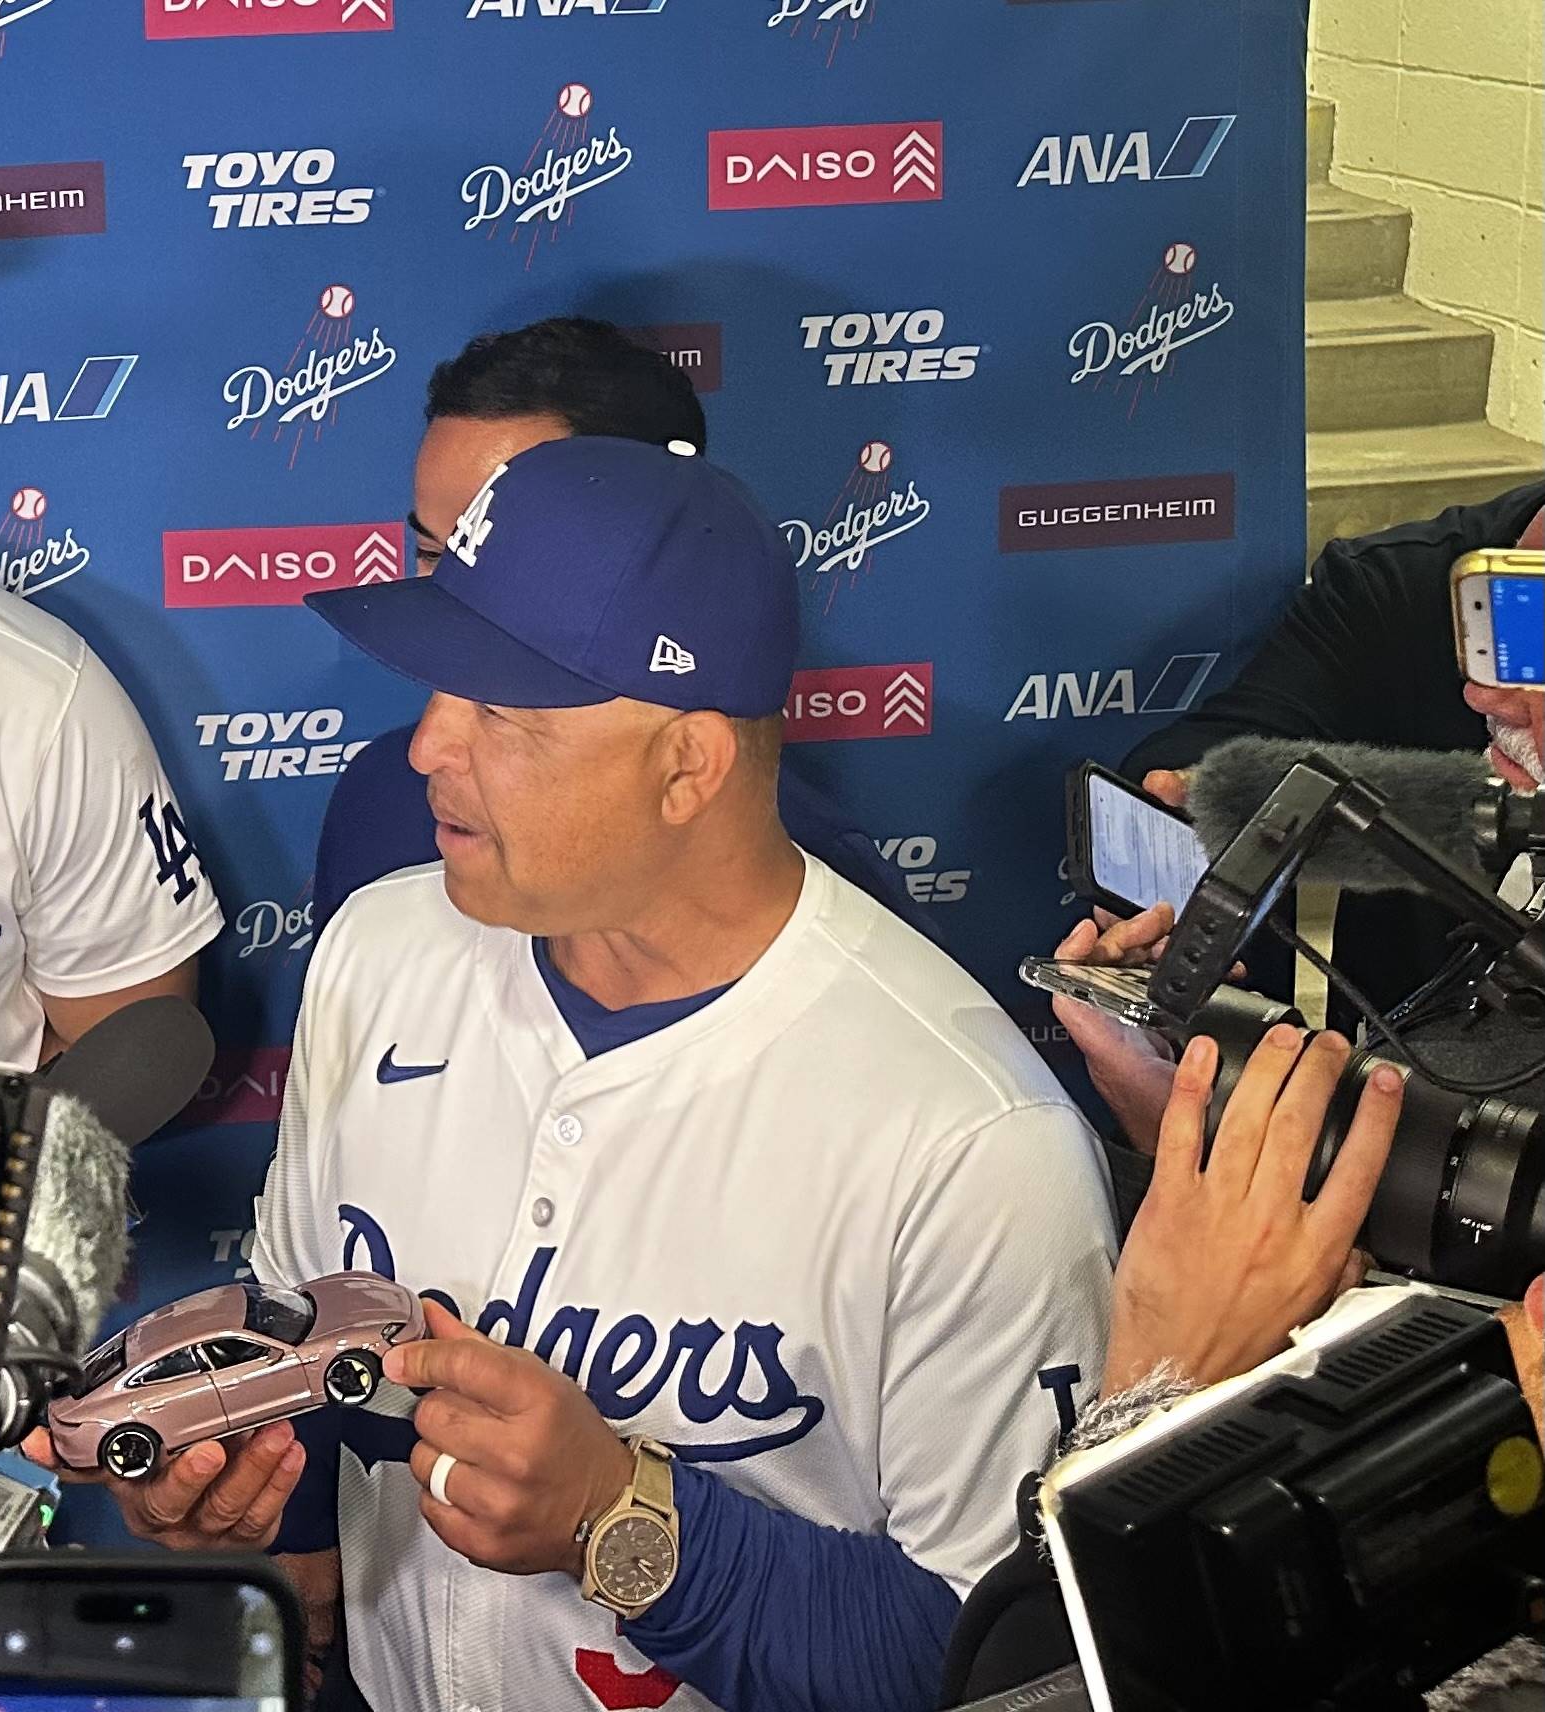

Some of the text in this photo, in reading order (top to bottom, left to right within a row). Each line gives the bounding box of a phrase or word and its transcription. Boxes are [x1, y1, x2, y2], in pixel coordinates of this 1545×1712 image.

[182, 148, 335, 189] TOYO
[461, 127, 632, 230] Dodgers
[727, 151, 875, 184] DAISO
[1017, 132, 1151, 187] ANA
[208, 187, 373, 229] TIRES
[800, 309, 944, 348] TOYO
[1069, 283, 1233, 383] Dodgers
[223, 328, 396, 430] Dodgers
[823, 345, 980, 386] TIRES
[1017, 497, 1216, 528] GUGGENHEIM
[181, 551, 337, 583] DAISO
[796, 690, 867, 720] ISO
[1005, 669, 1135, 722] ANA
[194, 708, 343, 746] TOYO
[197, 1070, 278, 1101] DAI
